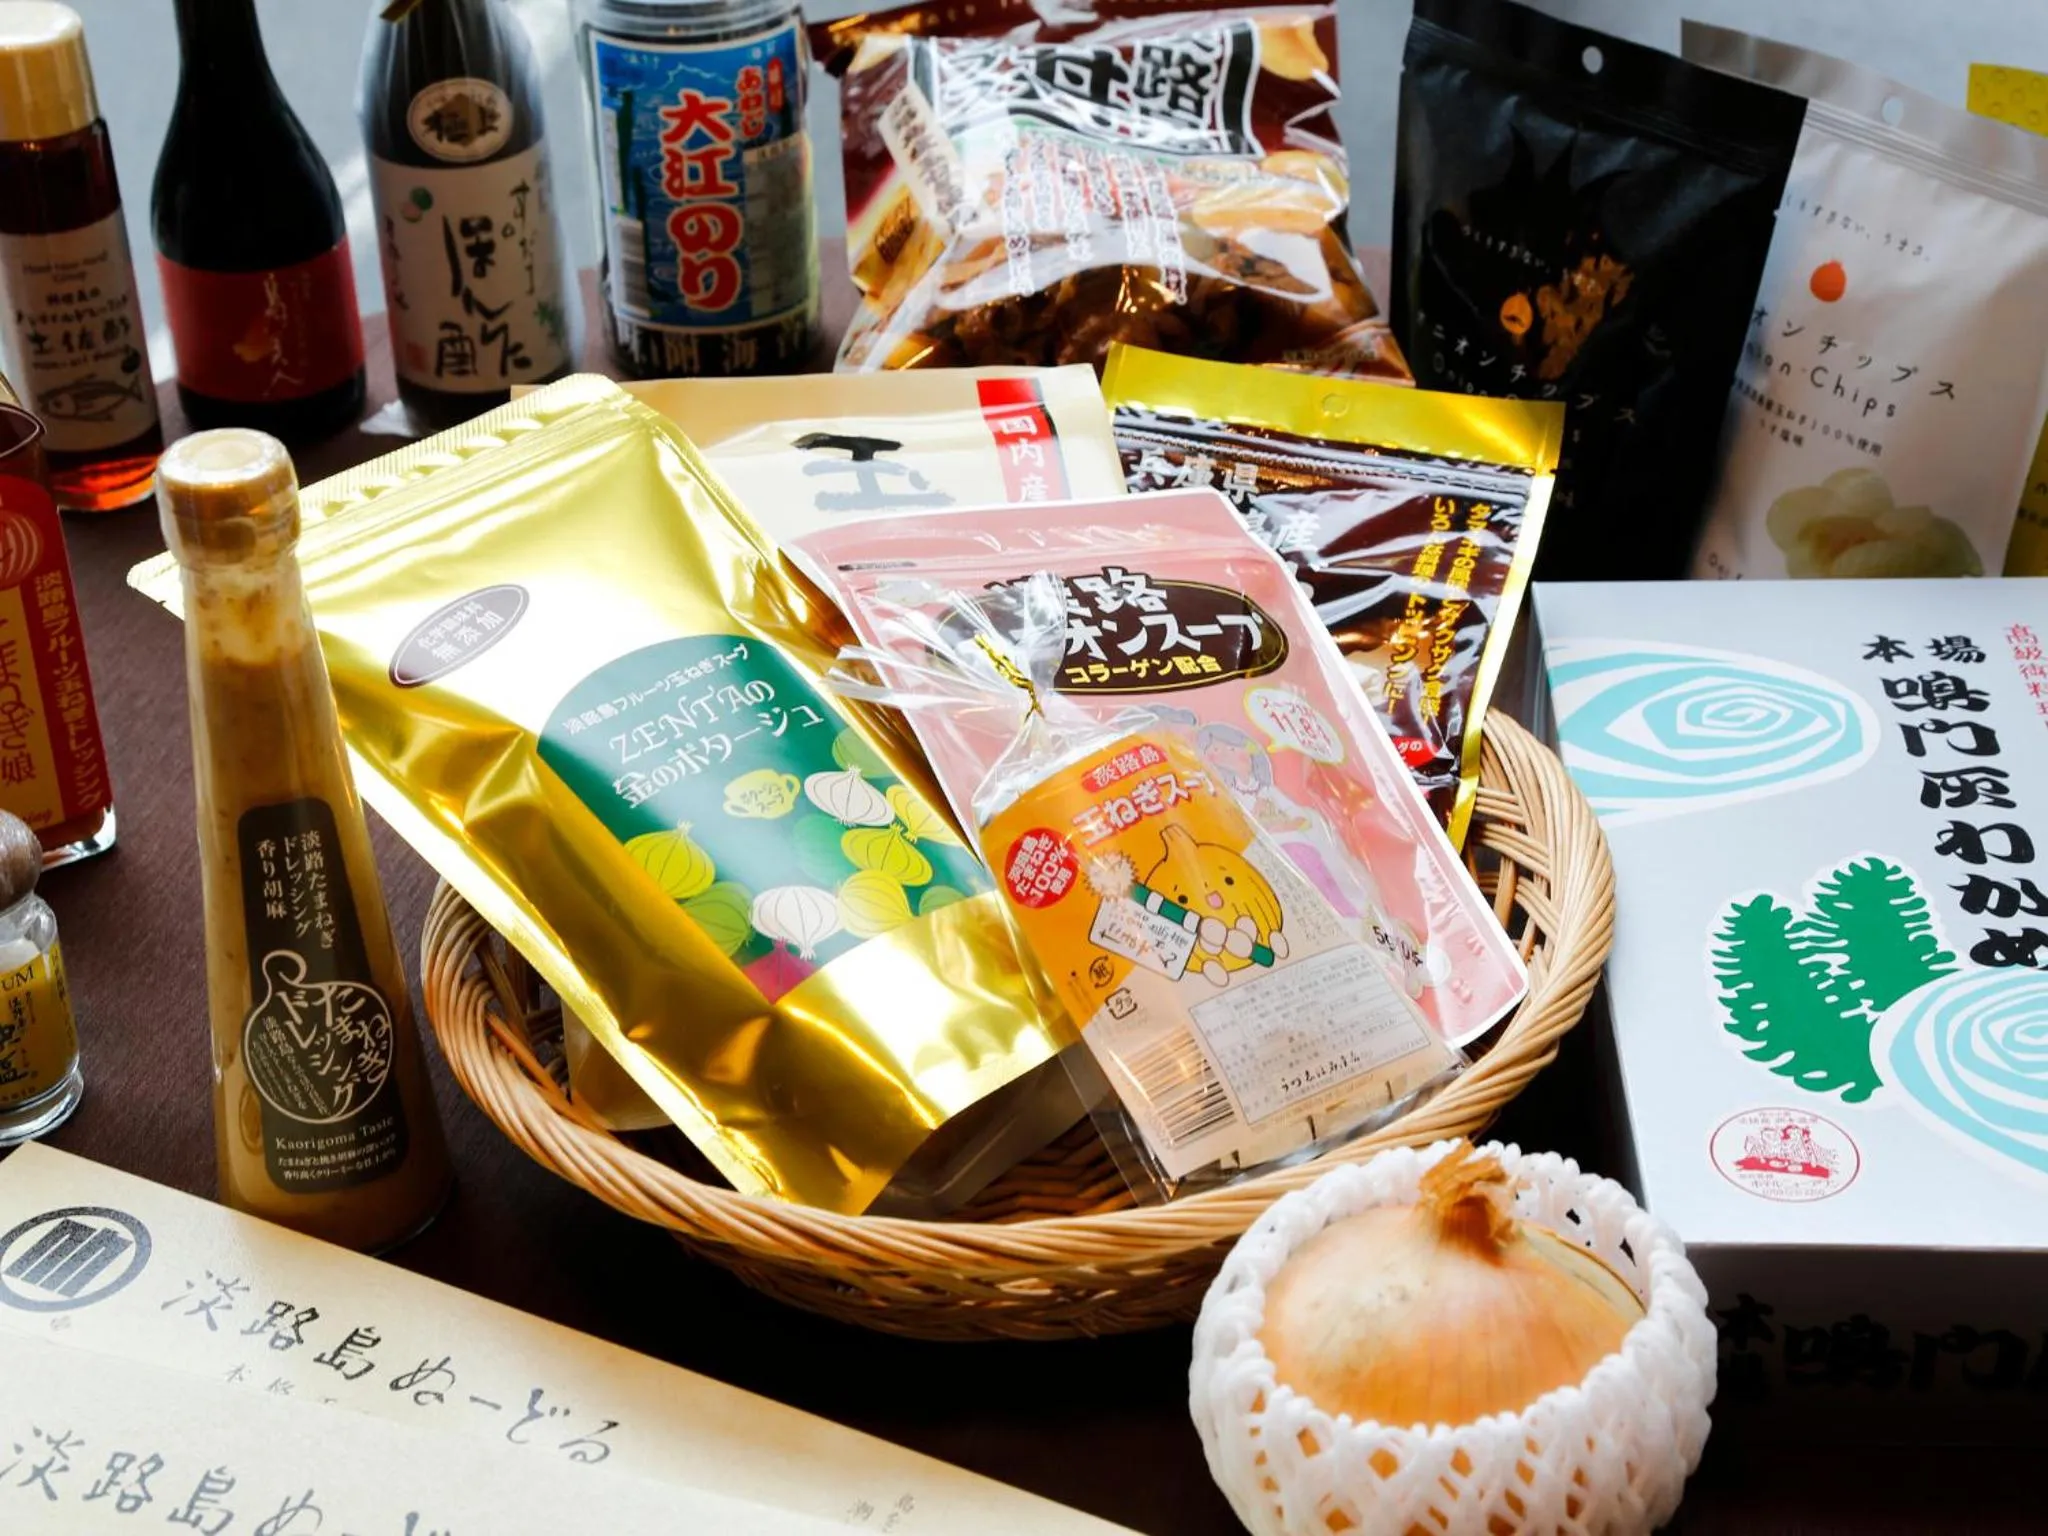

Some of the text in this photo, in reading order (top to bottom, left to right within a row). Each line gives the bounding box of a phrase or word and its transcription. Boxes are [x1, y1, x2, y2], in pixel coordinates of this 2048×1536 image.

[659, 88, 742, 313] 大江のり
[1809, 363, 1899, 419] Chips
[790, 430, 957, 512] 玉
[999, 414, 1052, 502] 国内産
[1064, 653, 1223, 686] コラーゲン配合
[1862, 633, 1987, 666] 本場
[1090, 744, 1162, 789] 淡路島
[256, 838, 287, 920] 香り胡麻
[283, 836, 312, 939] ドレッシング
[300, 829, 336, 949] 淡路たまねぎ
[275, 1132, 356, 1152] Kaorigoma
